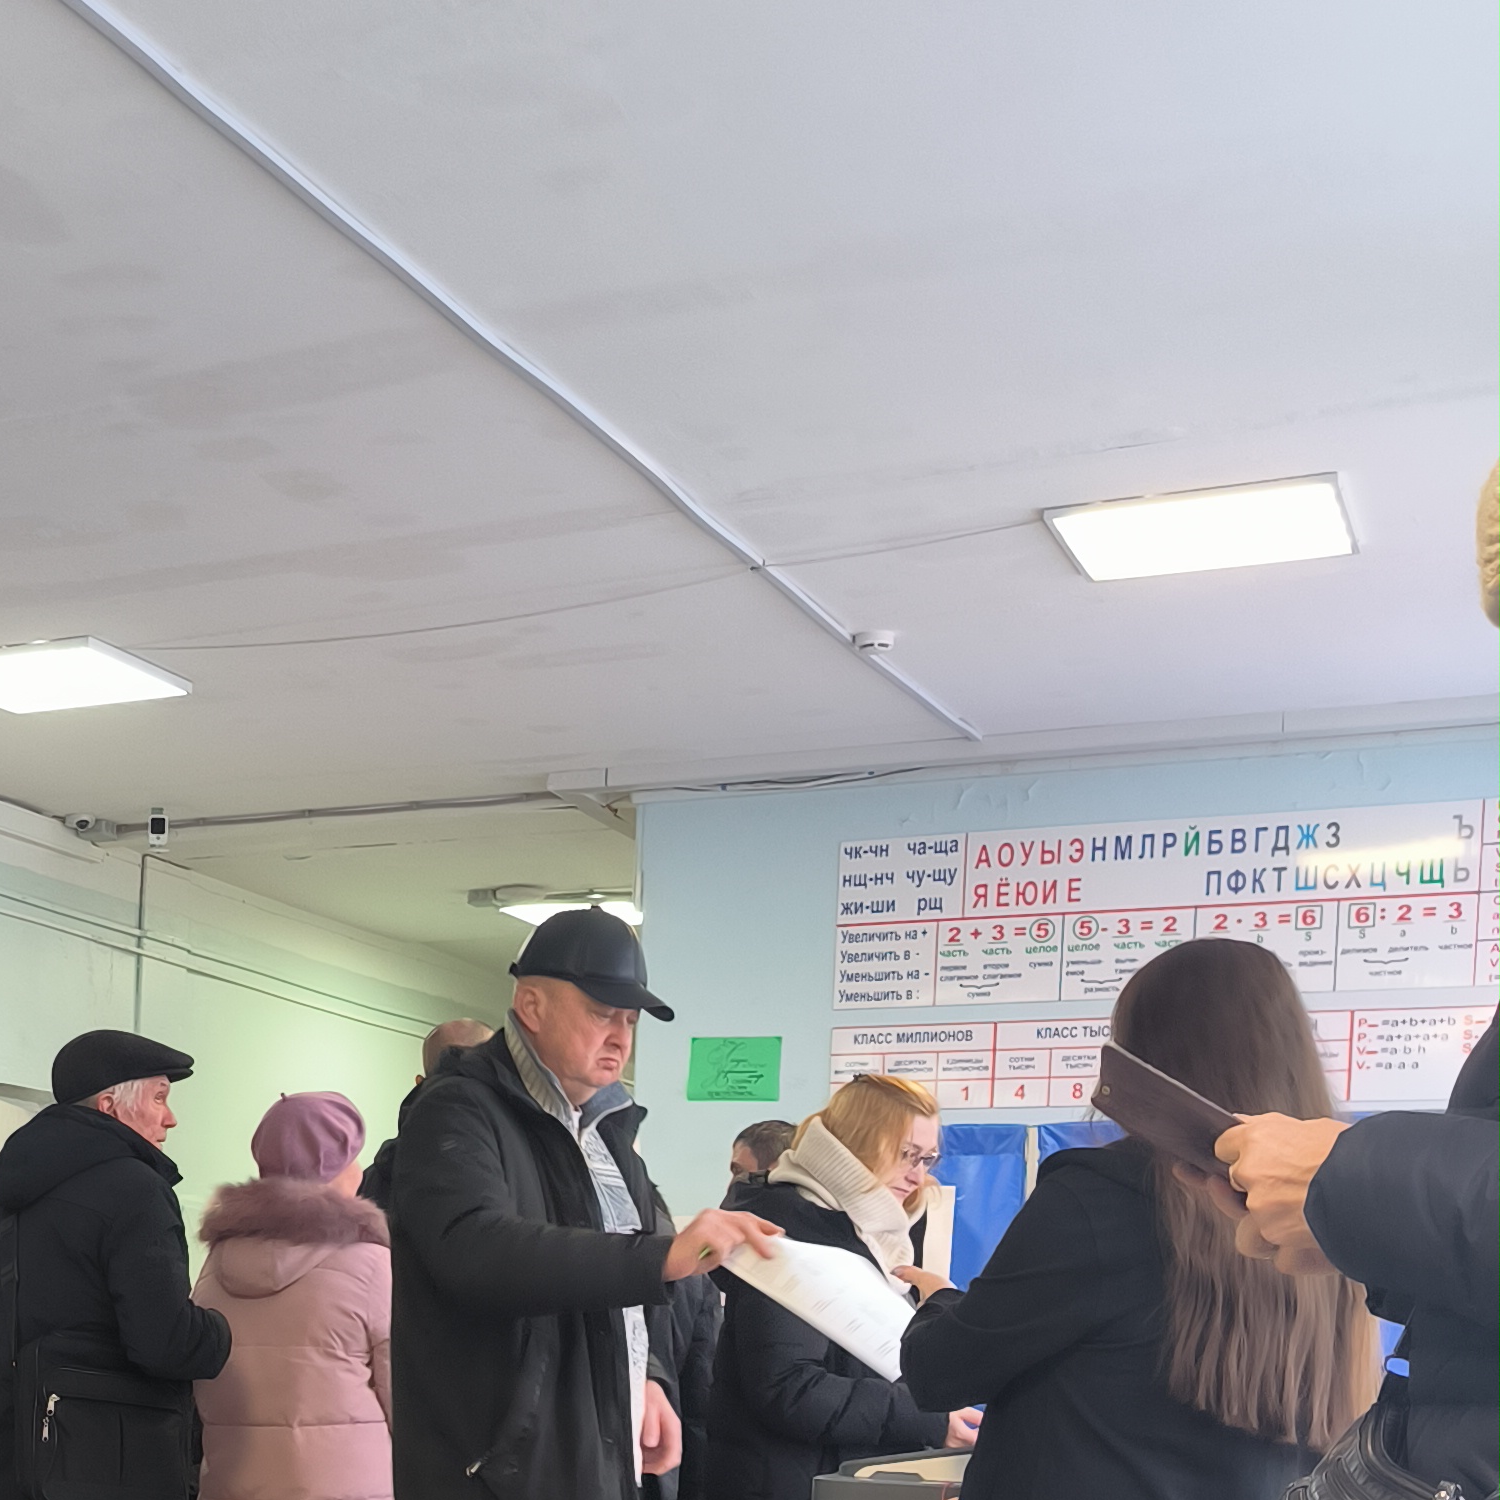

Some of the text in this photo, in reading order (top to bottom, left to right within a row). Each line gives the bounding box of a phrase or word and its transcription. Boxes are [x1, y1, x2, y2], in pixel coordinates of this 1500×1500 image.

[844, 839, 959, 859] чк-чн ча-ща
[842, 867, 957, 889] нщ-нч чу-щу
[840, 897, 943, 916] жи-ши рщ
[1354, 906, 1370, 923] 6
[1397, 904, 1413, 921] 2
[1448, 902, 1463, 919] 3
[1078, 920, 1093, 937] 5
[1117, 918, 1131, 935] 3
[1162, 916, 1178, 933] 2
[1213, 914, 1229, 930] 2
[1253, 912, 1268, 929] 3
[1301, 909, 1316, 926] 6
[841, 929, 901, 944] Увеличить
[904, 928, 918, 940] на
[948, 926, 961, 943] 2
[992, 924, 1005, 941] 3
[1035, 921, 1050, 939] 5
[982, 947, 1012, 956] часть
[1025, 944, 1059, 955] целое
[1067, 942, 1100, 953] целое
[1113, 940, 1145, 949] часть
[840, 950, 900, 964] Увеличить
[903, 950, 911, 961] в
[939, 949, 969, 958] часть
[839, 970, 903, 983] Уменьшить
[906, 968, 919, 980] на
[838, 989, 902, 1003] Уменьшить
[905, 990, 913, 1000] в
[853, 1030, 974, 1045] КЛАСС МИЛЛИОНОВ
[1036, 1026, 1078, 1039] КЛАСС
[960, 1086, 969, 1101] 1
[1014, 1084, 1026, 1099] 4
[1072, 1082, 1083, 1098] 8
